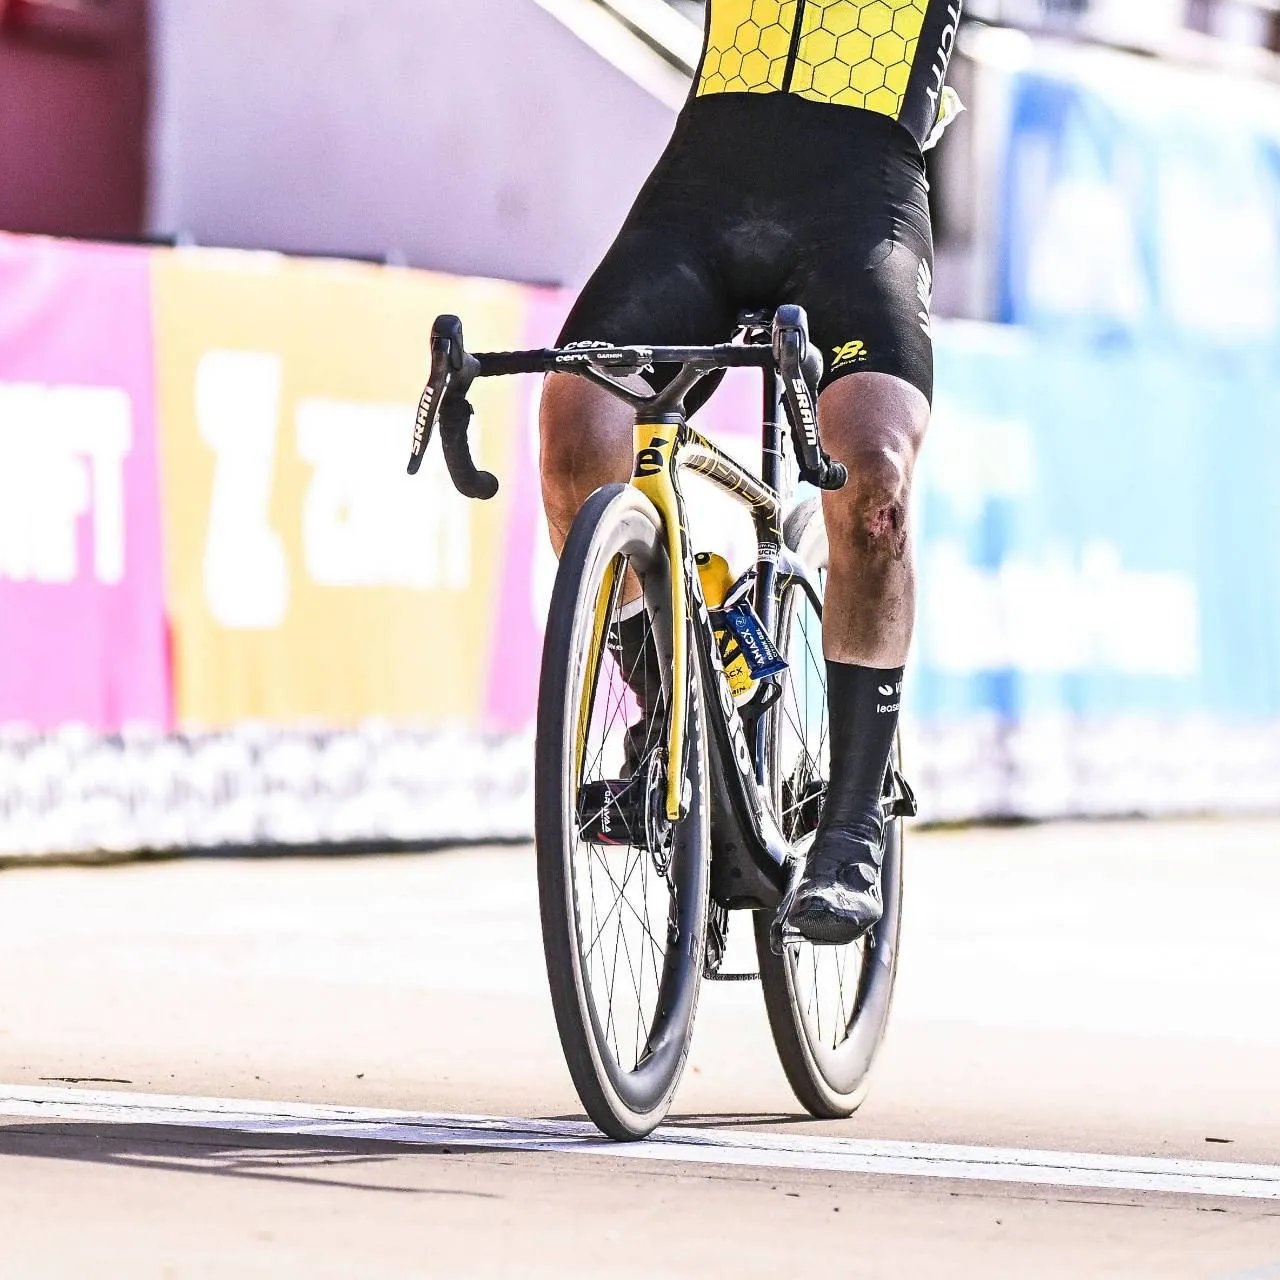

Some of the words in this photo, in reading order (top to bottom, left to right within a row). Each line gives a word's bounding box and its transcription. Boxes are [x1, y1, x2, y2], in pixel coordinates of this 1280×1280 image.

[412, 385, 435, 457] SRAM
[792, 378, 817, 447] SRAM
[741, 628, 765, 666] AMACX
